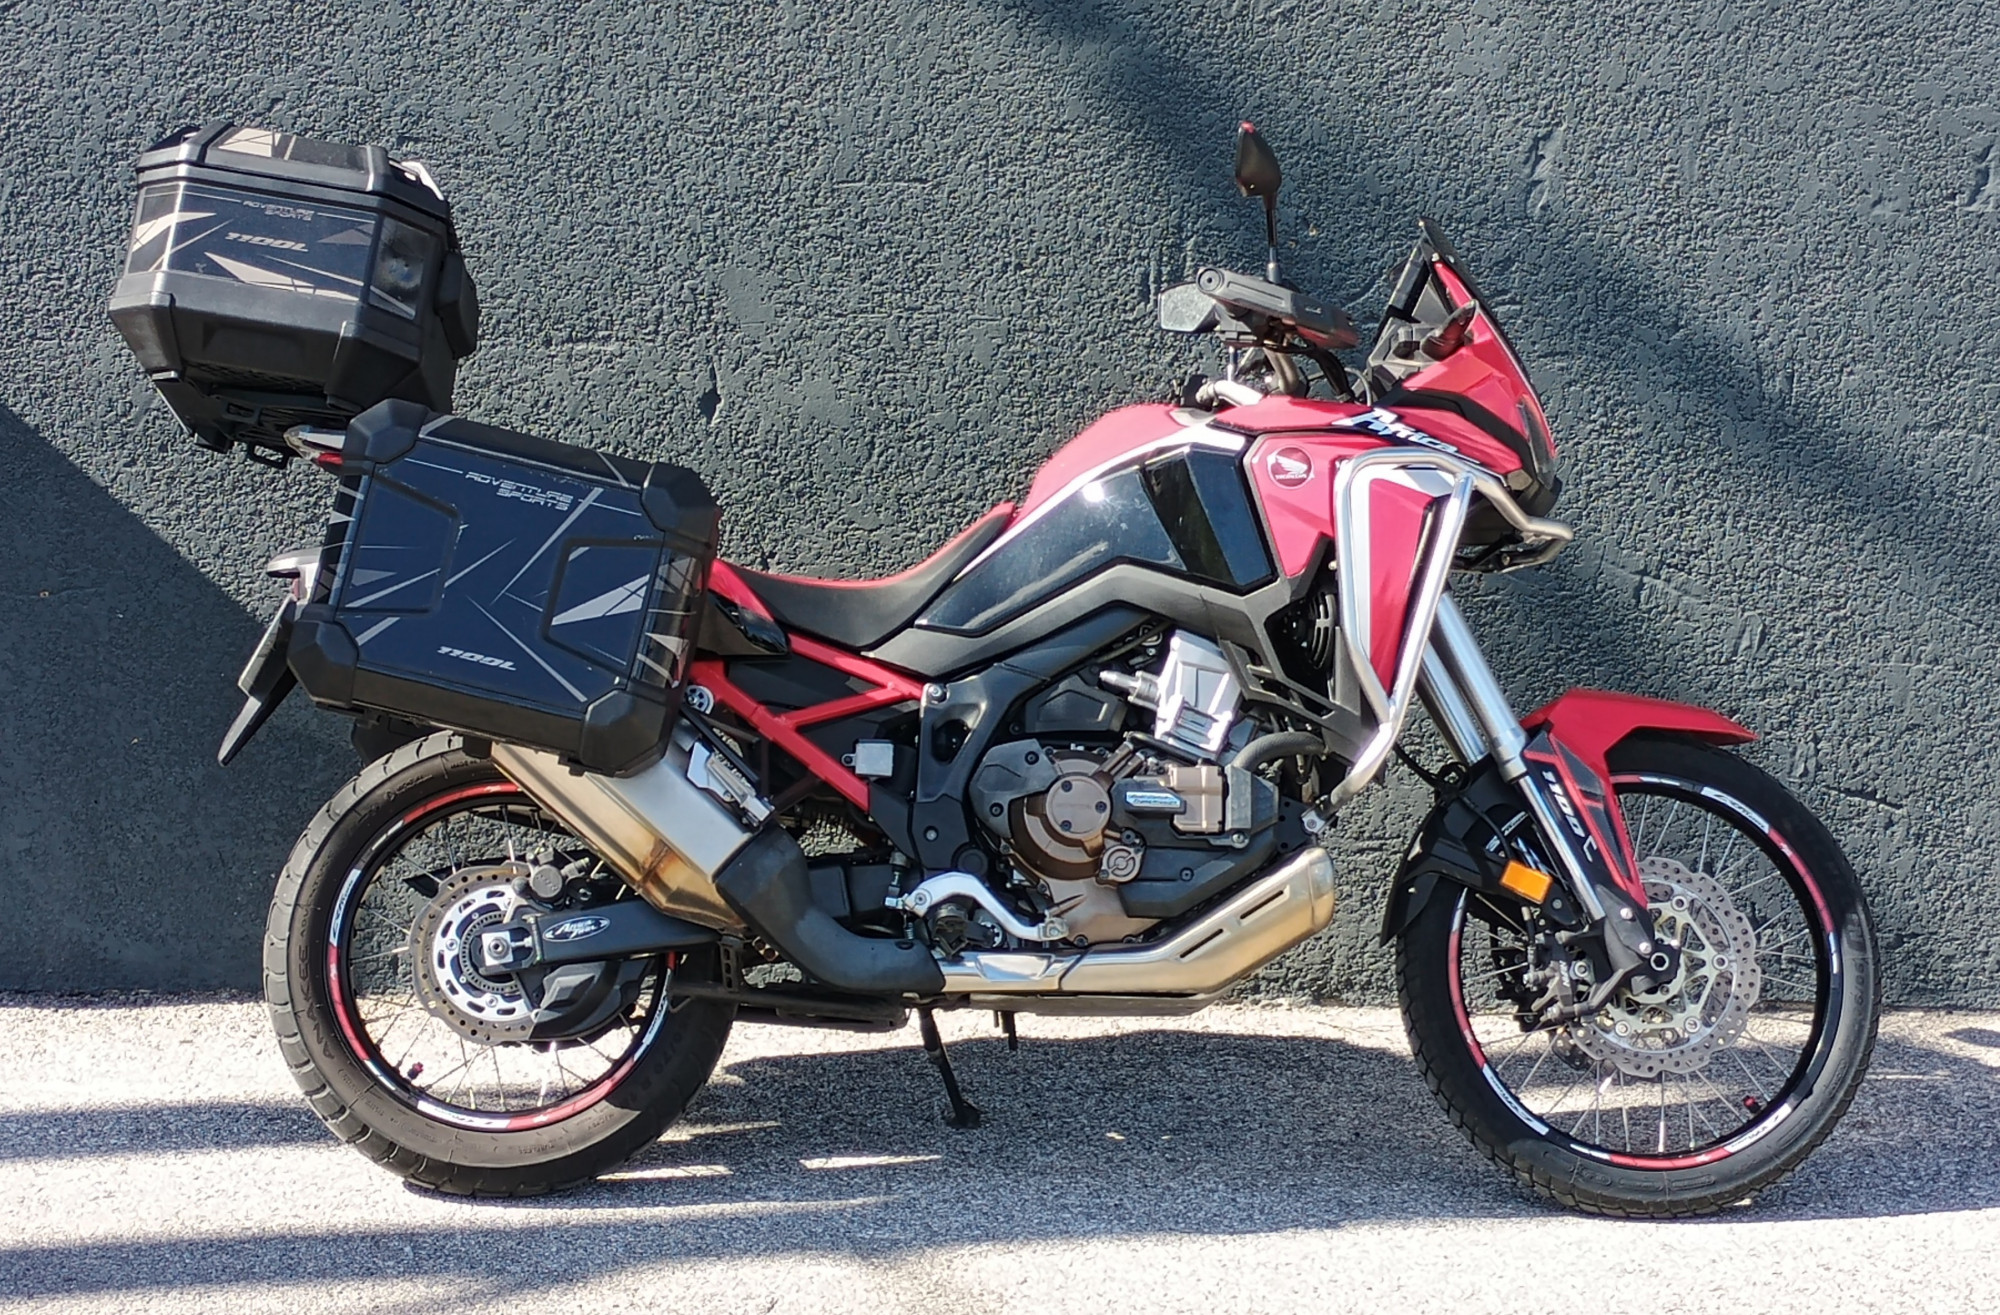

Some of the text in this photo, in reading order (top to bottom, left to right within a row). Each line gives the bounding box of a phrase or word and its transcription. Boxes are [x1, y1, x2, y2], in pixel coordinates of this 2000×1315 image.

[465, 471, 574, 503] ADVENTURE
[496, 488, 569, 511] SPORTS
[437, 645, 516, 671] 1100L
